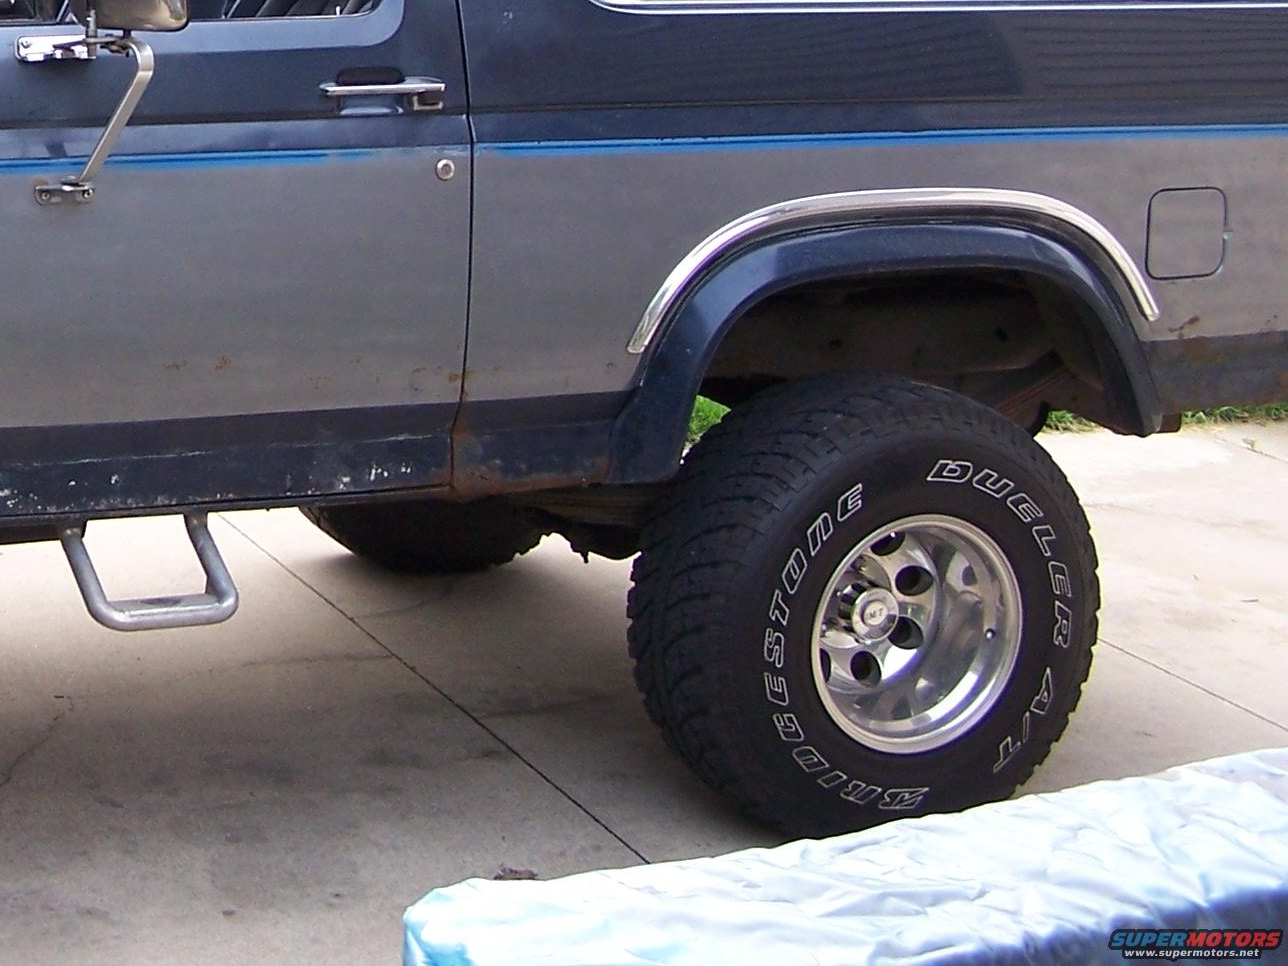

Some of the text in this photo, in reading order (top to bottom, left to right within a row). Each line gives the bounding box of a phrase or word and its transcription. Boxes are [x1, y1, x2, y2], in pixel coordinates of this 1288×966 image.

[763, 482, 930, 810] BRIDGESTONE
[926, 459, 1073, 774] DUELER A/T
